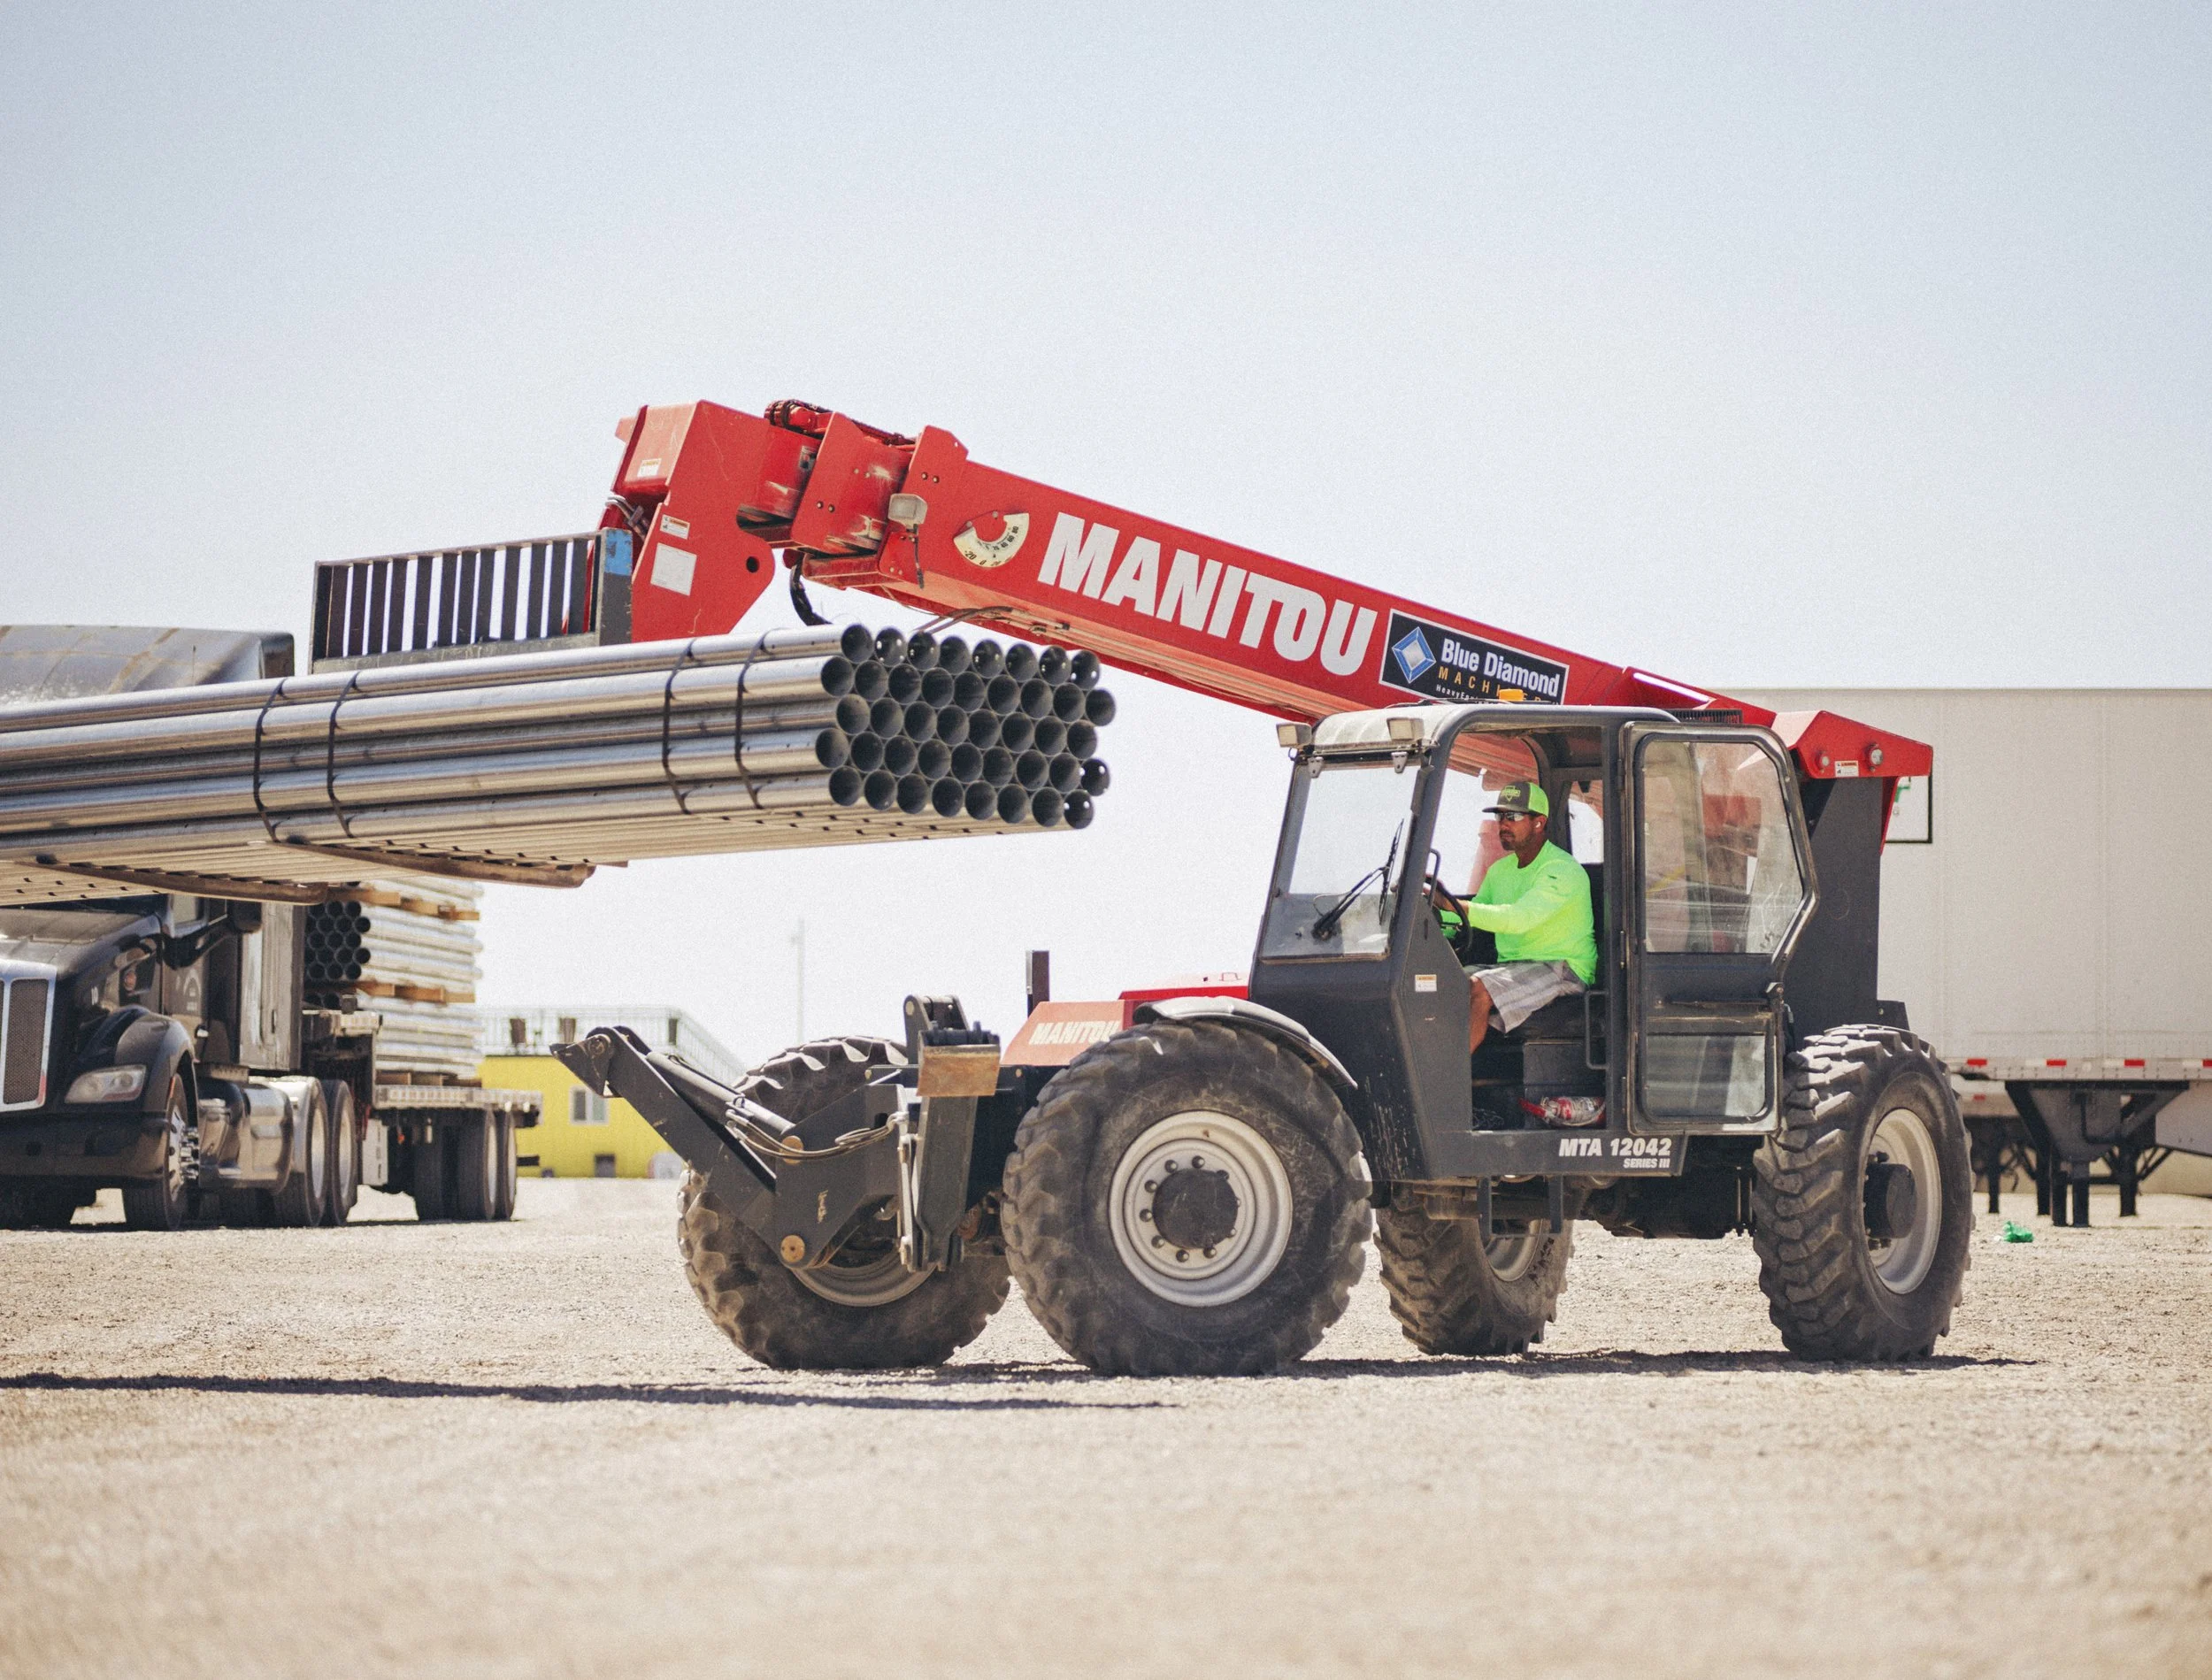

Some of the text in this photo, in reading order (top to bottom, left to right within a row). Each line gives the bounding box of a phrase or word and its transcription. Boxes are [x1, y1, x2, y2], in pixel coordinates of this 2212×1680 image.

[1037, 511, 1378, 676] MANITOU
[1441, 638, 1560, 697] Blue Diamond
[1558, 1138, 1672, 1156] MTA 12042
[1624, 1158, 1657, 1168] SERIES
